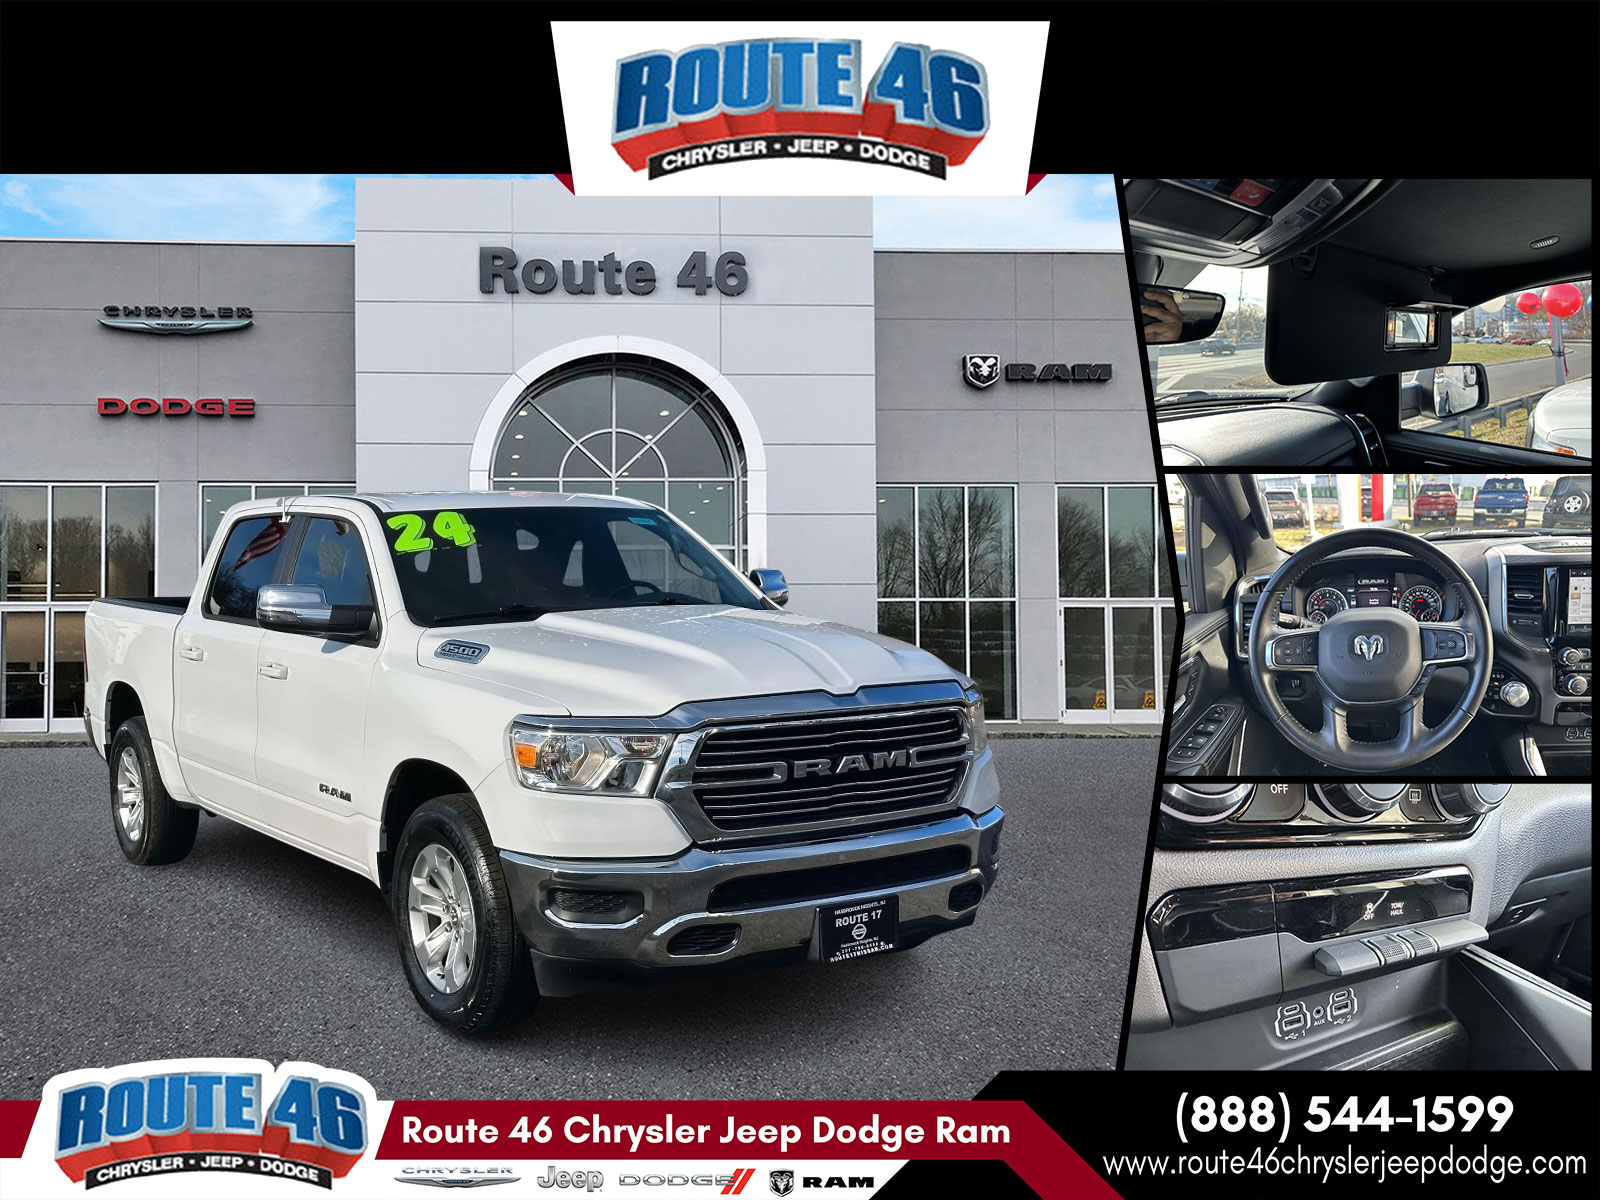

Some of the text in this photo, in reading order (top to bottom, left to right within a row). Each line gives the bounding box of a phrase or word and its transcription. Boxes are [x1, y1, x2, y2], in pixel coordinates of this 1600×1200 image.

[479, 246, 749, 296] Route 46
[103, 305, 253, 318] CHRYSLER
[1005, 363, 1112, 383] RAM
[97, 397, 255, 417] DODGE
[386, 511, 477, 554] 24
[793, 749, 907, 779] RAM
[319, 783, 352, 803] RAM
[1270, 784, 1289, 794] OFF
[835, 909, 882, 928] ROUTE 17
[1363, 912, 1375, 921] OFF
[1313, 1018, 1326, 1026] AUX
[1346, 1014, 1352, 1022] 2
[1301, 1029, 1306, 1037] 1
